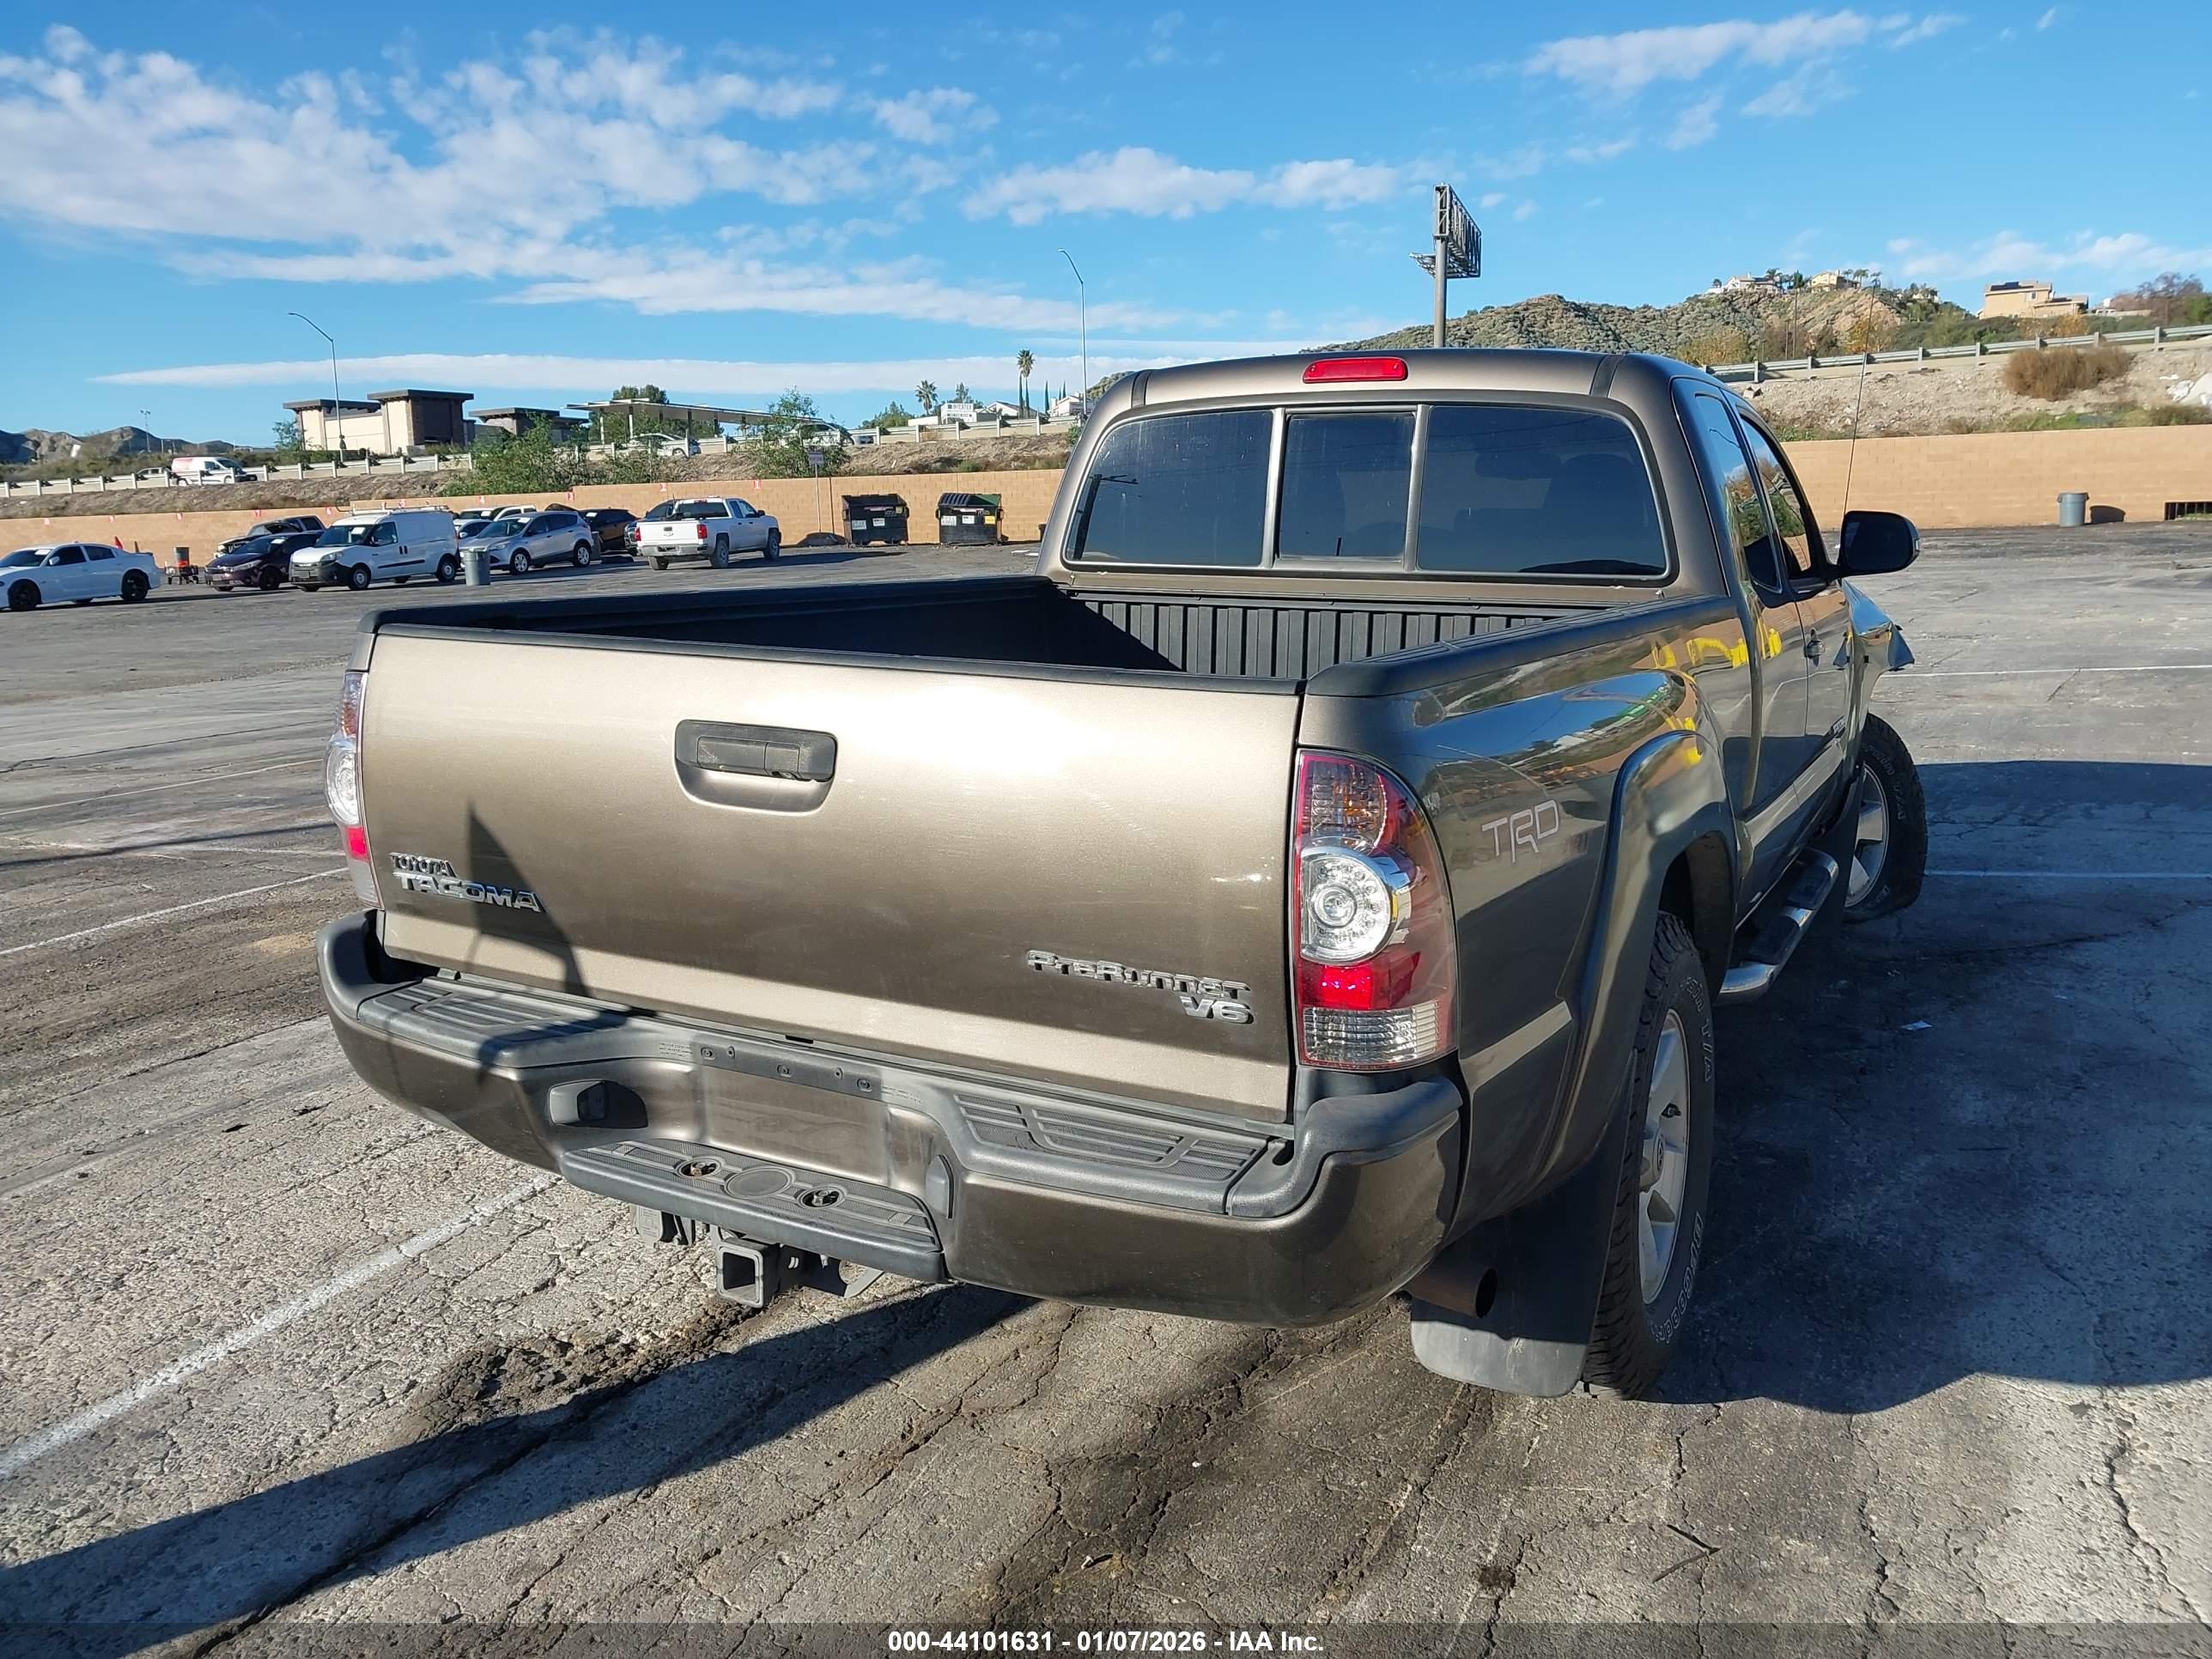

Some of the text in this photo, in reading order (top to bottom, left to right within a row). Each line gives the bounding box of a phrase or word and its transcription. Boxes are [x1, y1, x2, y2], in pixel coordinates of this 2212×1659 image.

[1482, 799, 1559, 864] TRD
[388, 851, 457, 878] TOYOTA
[392, 872, 548, 913] TACOMA
[1180, 996, 1255, 1024] V6
